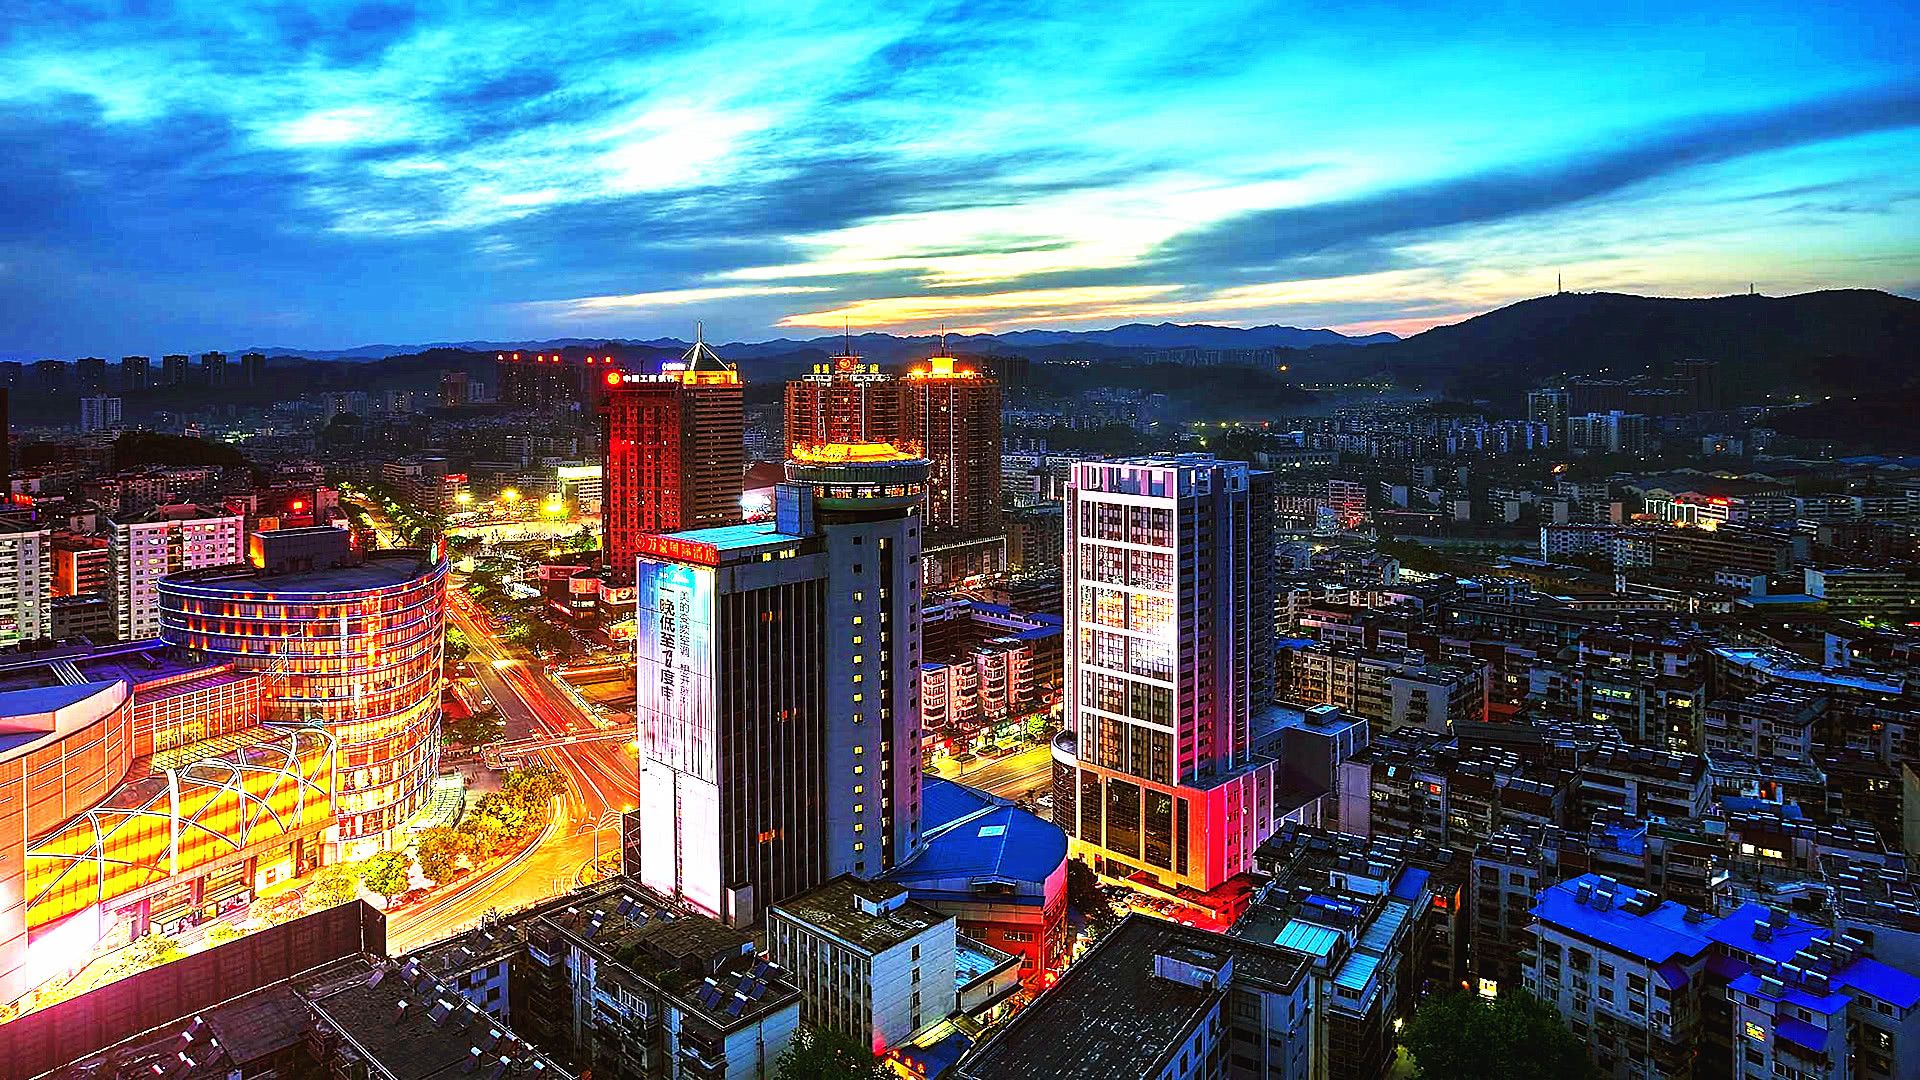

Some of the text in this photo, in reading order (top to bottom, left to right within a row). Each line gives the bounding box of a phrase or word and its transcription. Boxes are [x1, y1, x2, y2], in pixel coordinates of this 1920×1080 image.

[647, 537, 715, 563] 万豪国际酒店
